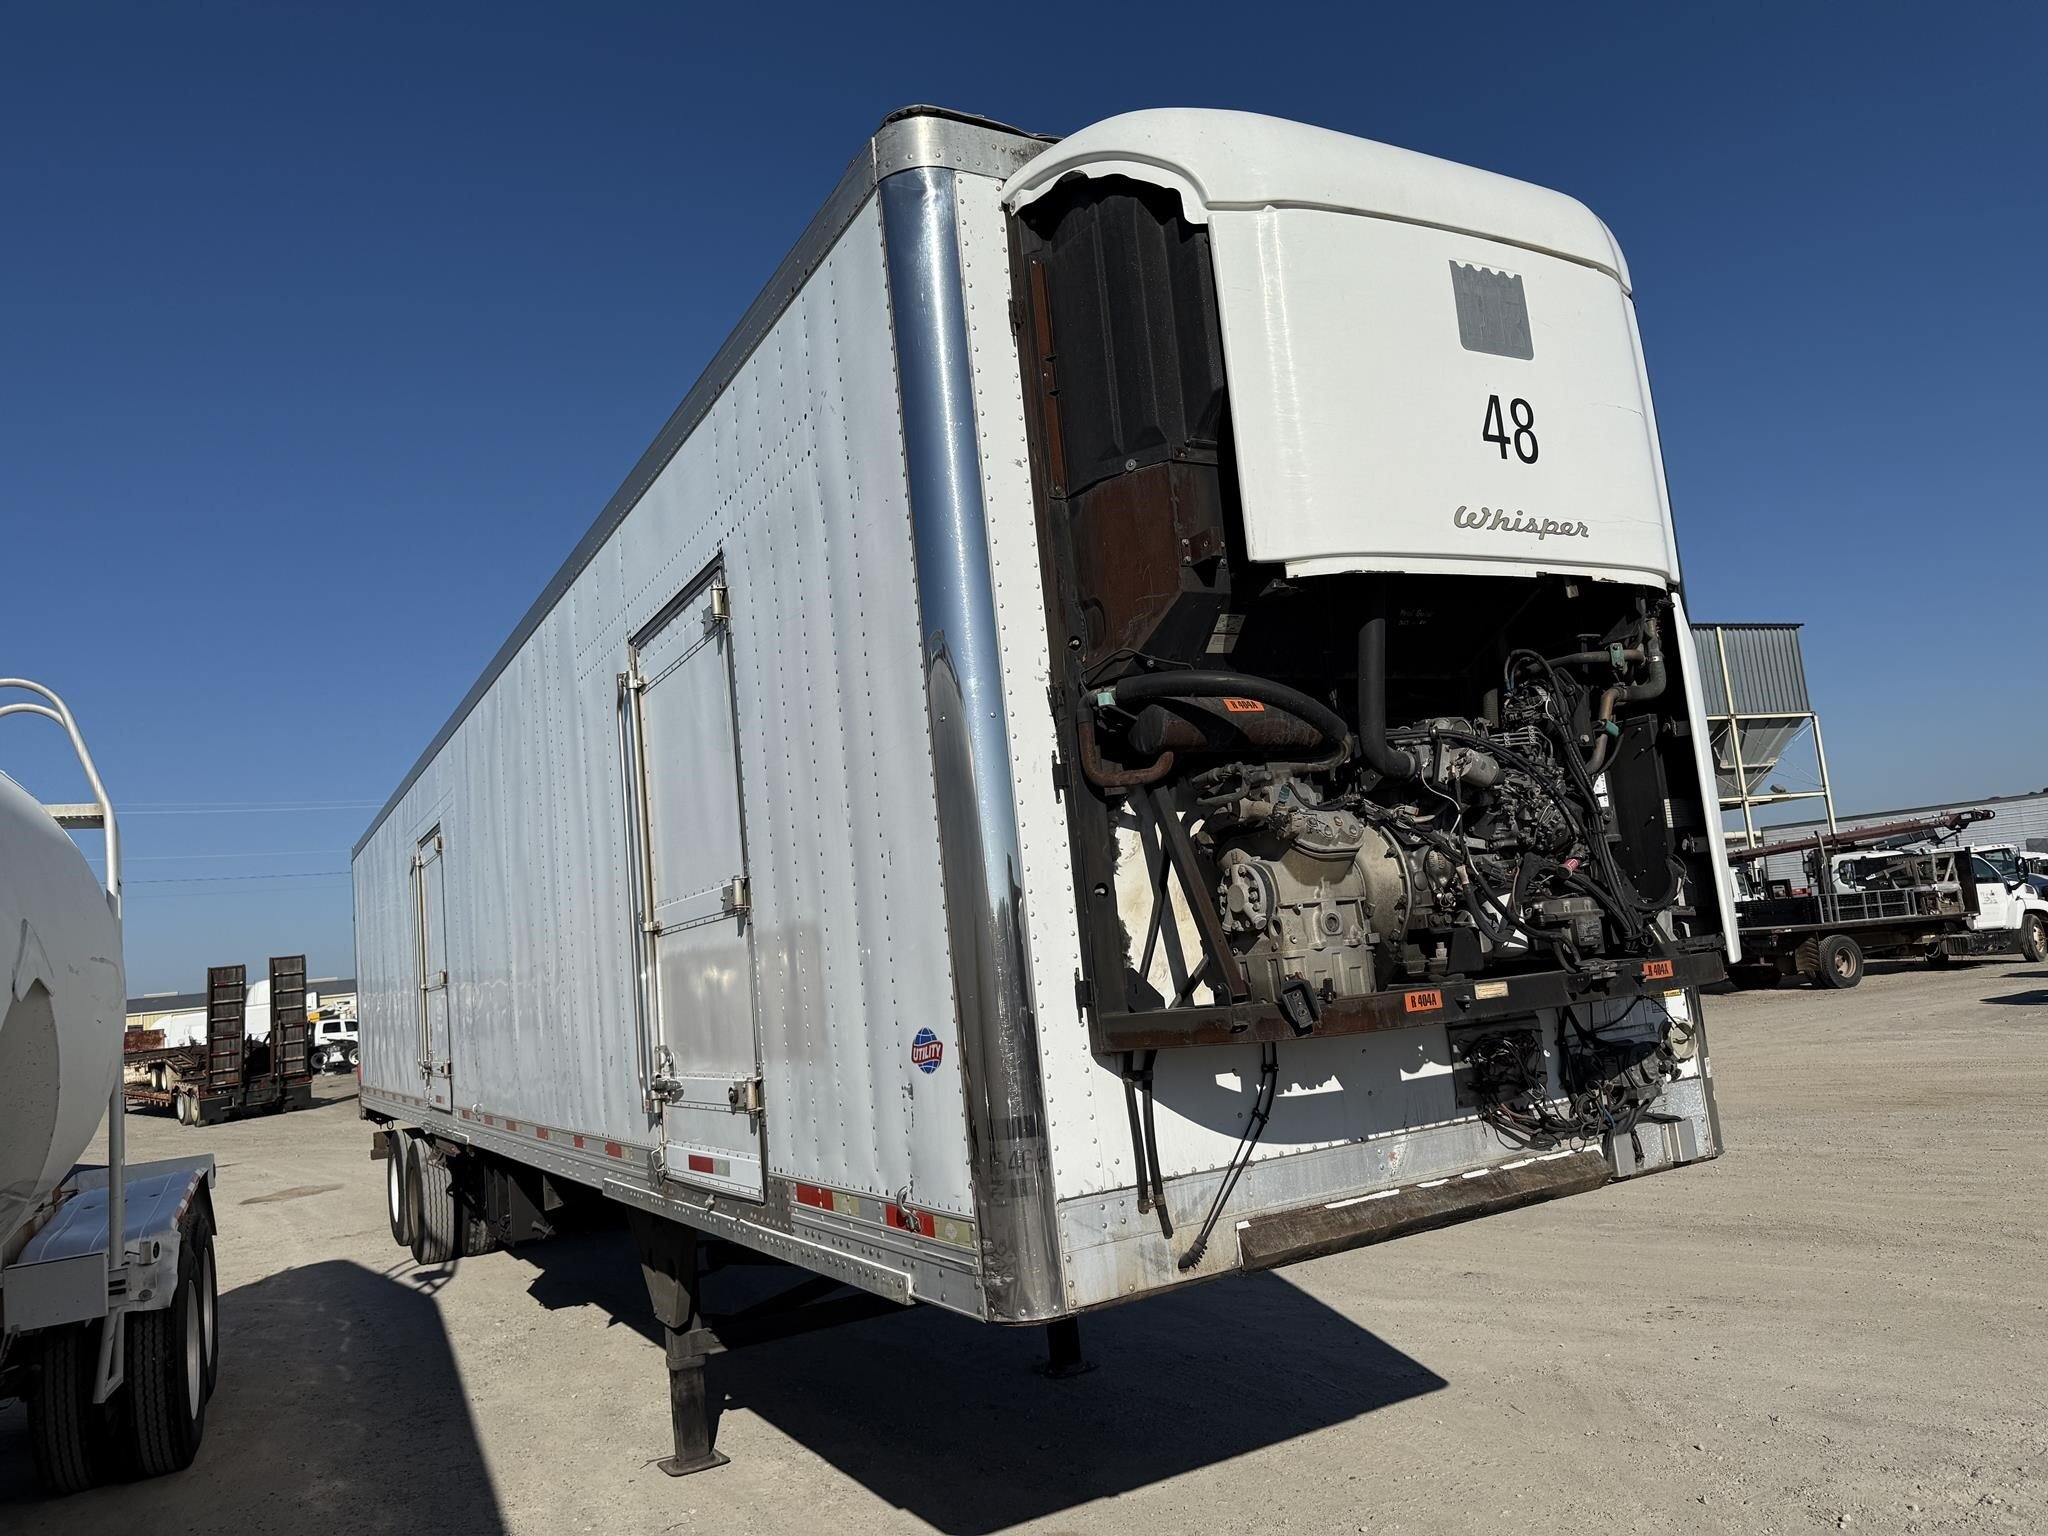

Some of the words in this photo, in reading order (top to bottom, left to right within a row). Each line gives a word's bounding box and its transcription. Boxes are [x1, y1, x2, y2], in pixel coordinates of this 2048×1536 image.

[1482, 394, 1539, 465] 48
[1453, 504, 1590, 541] Whisper
[1653, 963, 1669, 976] 404A
[1411, 995, 1417, 1008] R
[1418, 993, 1437, 1007] 404A
[912, 1044, 941, 1061] UTILITY
